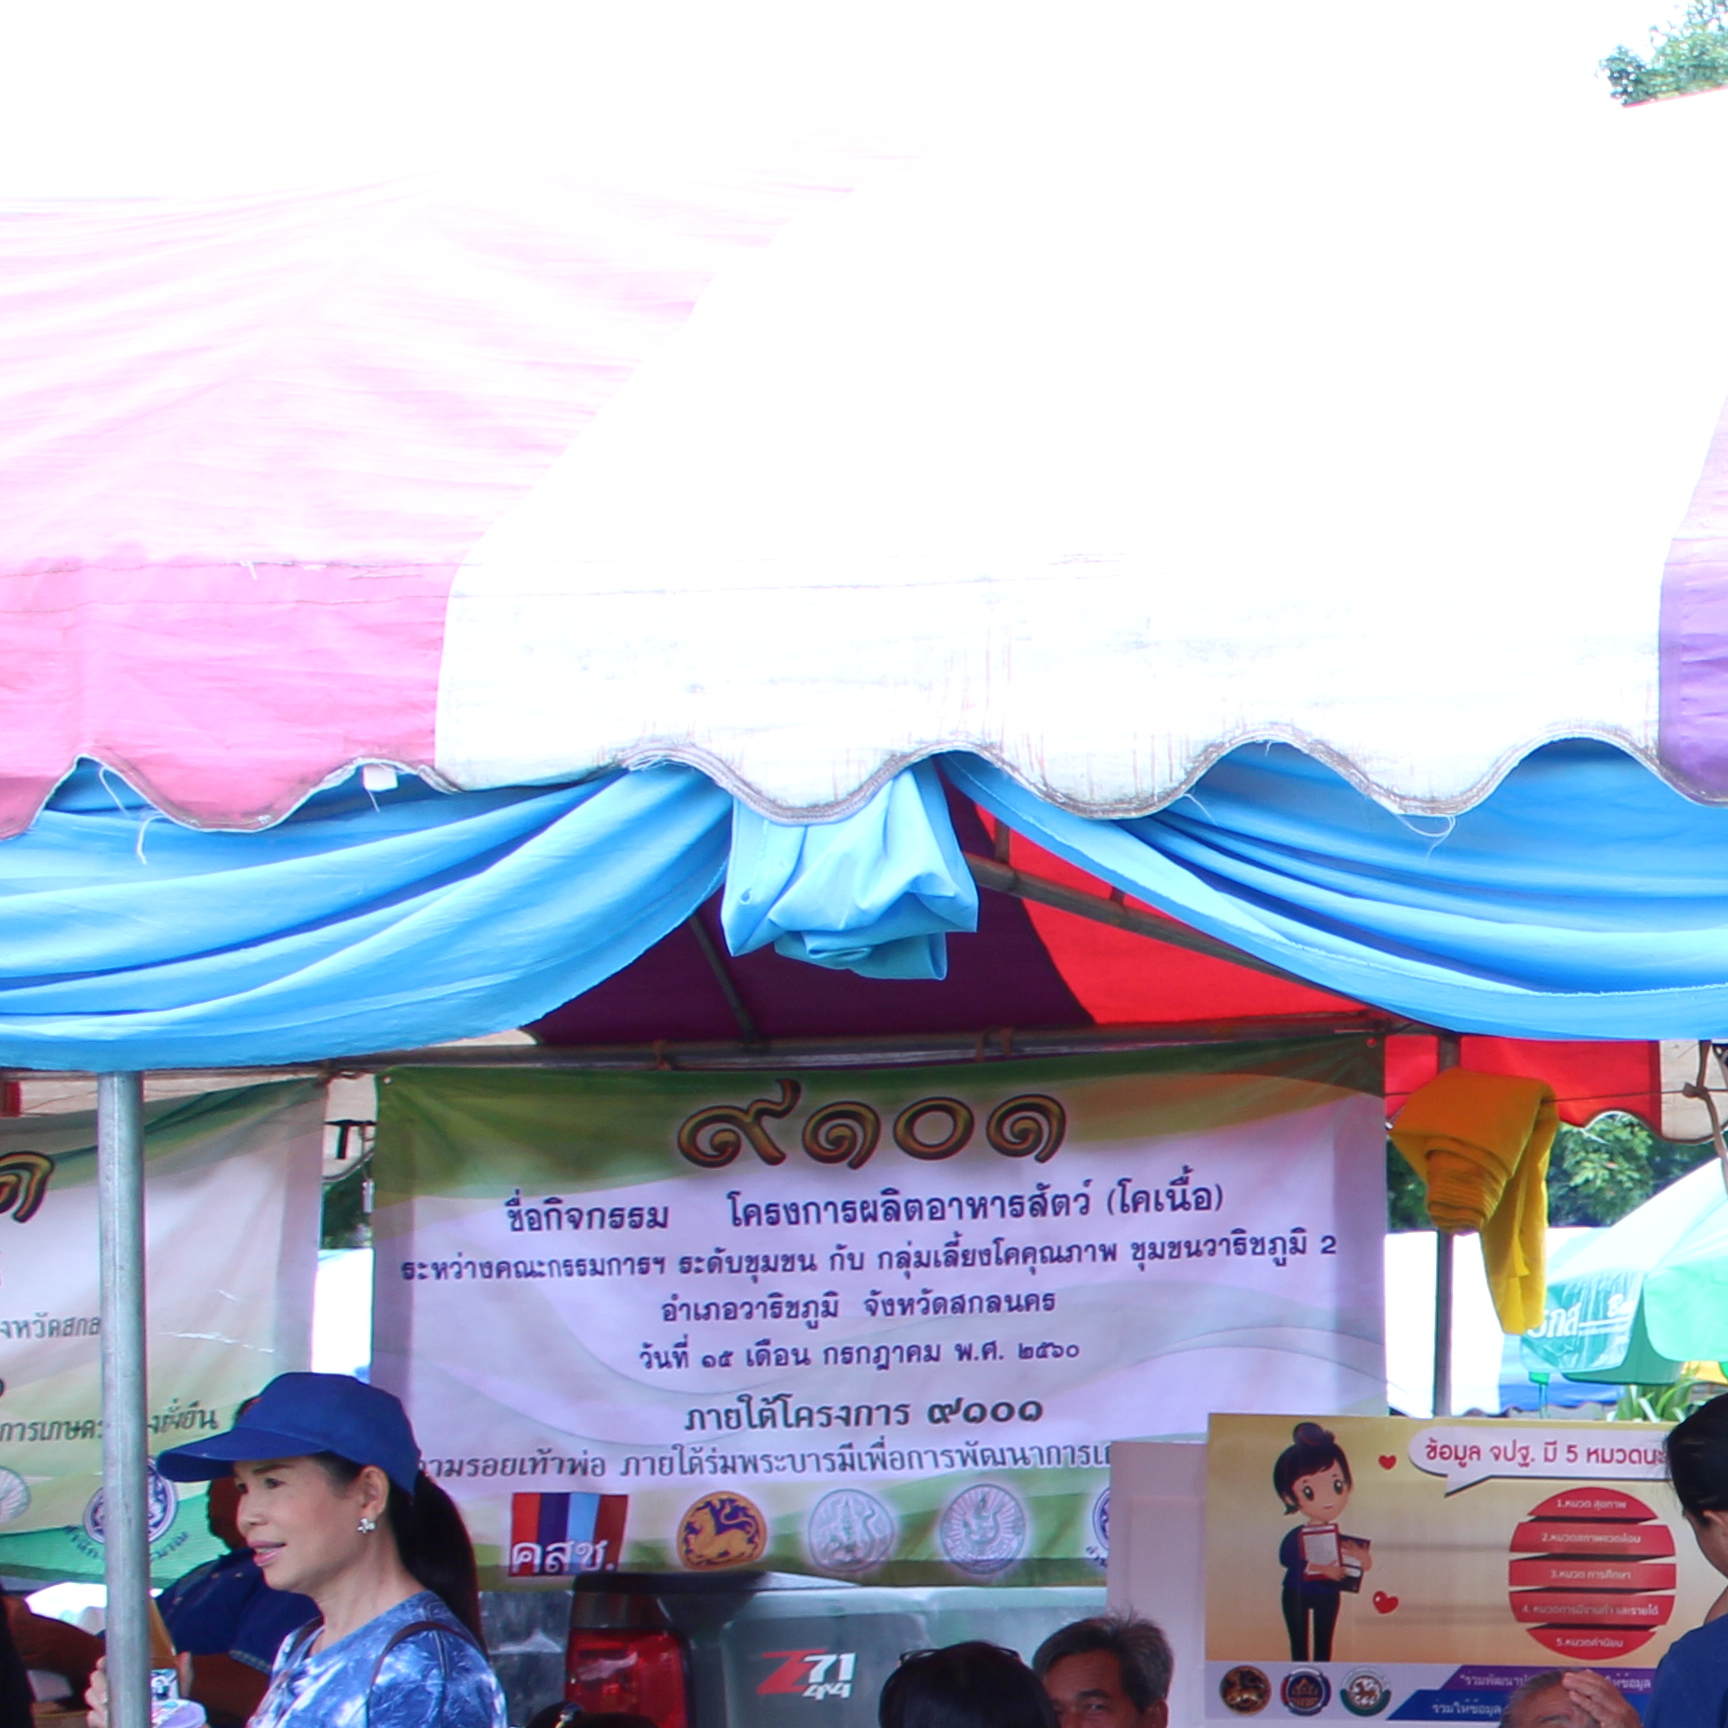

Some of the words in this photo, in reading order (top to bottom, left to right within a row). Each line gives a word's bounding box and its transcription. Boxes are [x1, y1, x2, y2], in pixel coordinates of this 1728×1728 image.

[676, 1077, 1066, 1171] ๙๑๐๑
[506, 1189, 669, 1232] ชื่อกิจกรรม
[726, 1178, 1092, 1228] โครงการผลิตอาหารสัตว์
[1106, 1166, 1224, 1217] (โคเนื้อ)
[400, 1251, 666, 1282] ระหว่างคณะกรรมการฯ
[677, 1246, 818, 1283] ระดับชุมชน
[828, 1242, 865, 1273] กับ
[877, 1231, 1118, 1279] กลุ่มเลี้ยงโคคุณภาพ
[1130, 1227, 1308, 1271] ชุมชนวาริชภูมิ
[1320, 1234, 1337, 1255] 2
[661, 1292, 840, 1330] อำเภอวาริชภูมิ
[863, 1288, 1057, 1318] จังหวัดสกลนคร
[639, 1335, 690, 1371] วันที่
[700, 1346, 735, 1369] ๑๕
[745, 1337, 811, 1368] เดือน
[822, 1341, 942, 1372] กรกฎาคม
[954, 1340, 1005, 1363] พ.ศ.
[1017, 1340, 1080, 1361] ๒๕๖๐
[685, 1392, 911, 1432] ภายใต้โครงการ
[927, 1396, 1044, 1426] ๙๑๐๑
[1425, 1436, 1482, 1469] ข้อมูล
[1489, 1443, 1536, 1469] จปฐ.
[1543, 1440, 1559, 1465] มี
[1566, 1444, 1579, 1464] 5
[512, 1539, 615, 1573] คสช.
[757, 1648, 858, 1696] Z71
